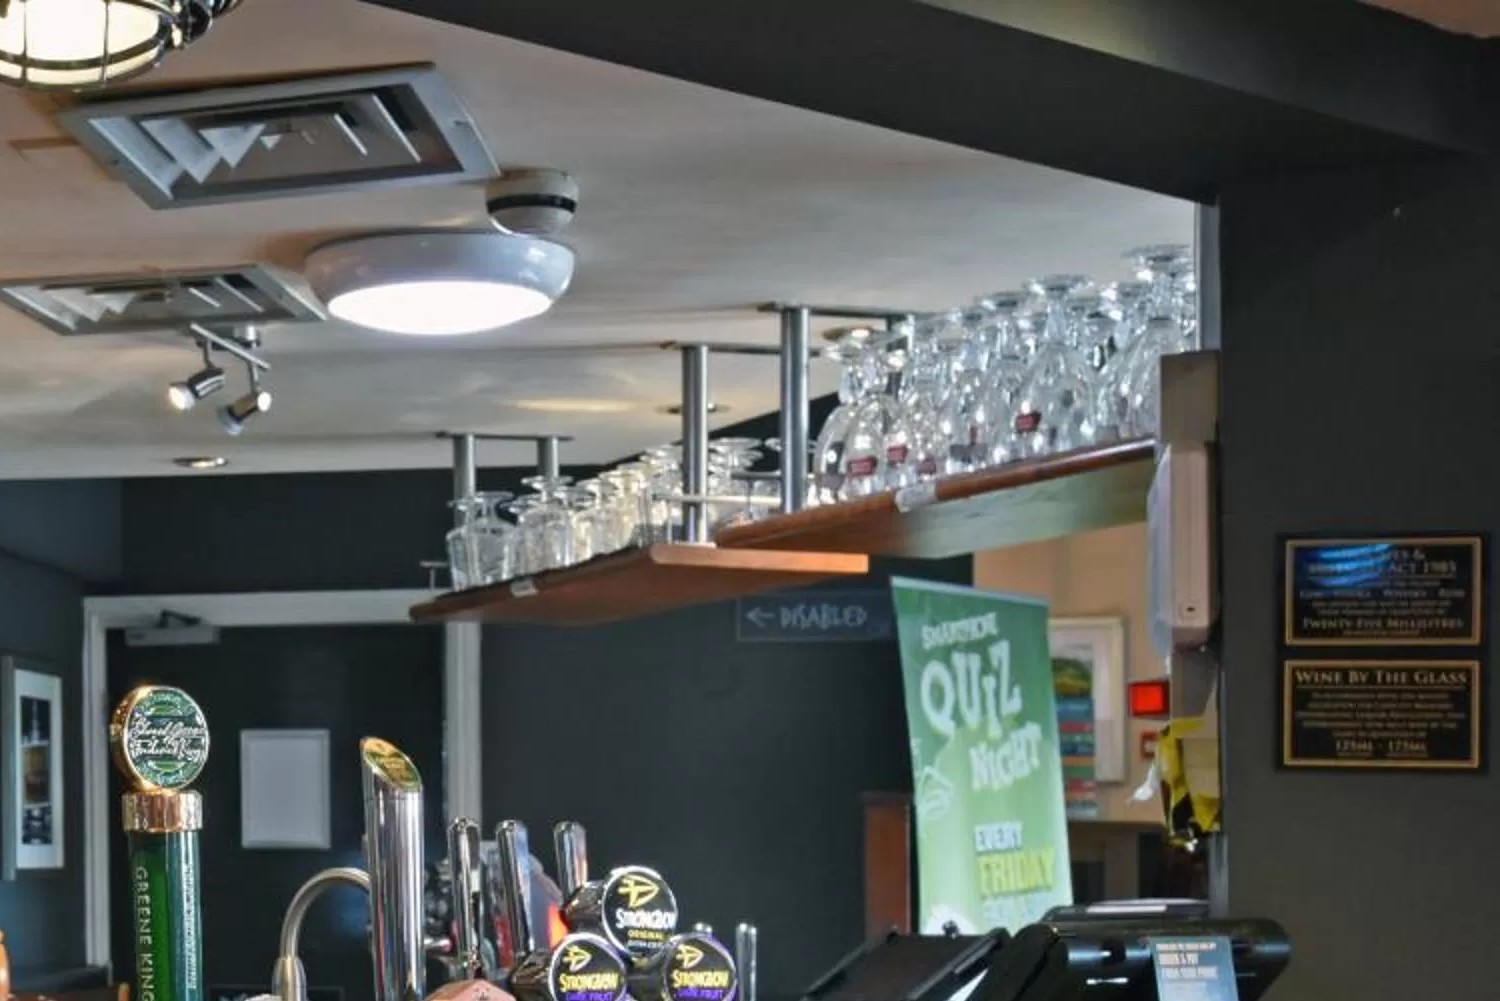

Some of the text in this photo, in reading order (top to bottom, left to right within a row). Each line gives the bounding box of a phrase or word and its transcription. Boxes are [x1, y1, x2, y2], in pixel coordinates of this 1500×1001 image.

[780, 602, 869, 630] DISABLED
[1295, 669, 1468, 684] WINE BY THE GLASS
[134, 866, 153, 945] GREENE
